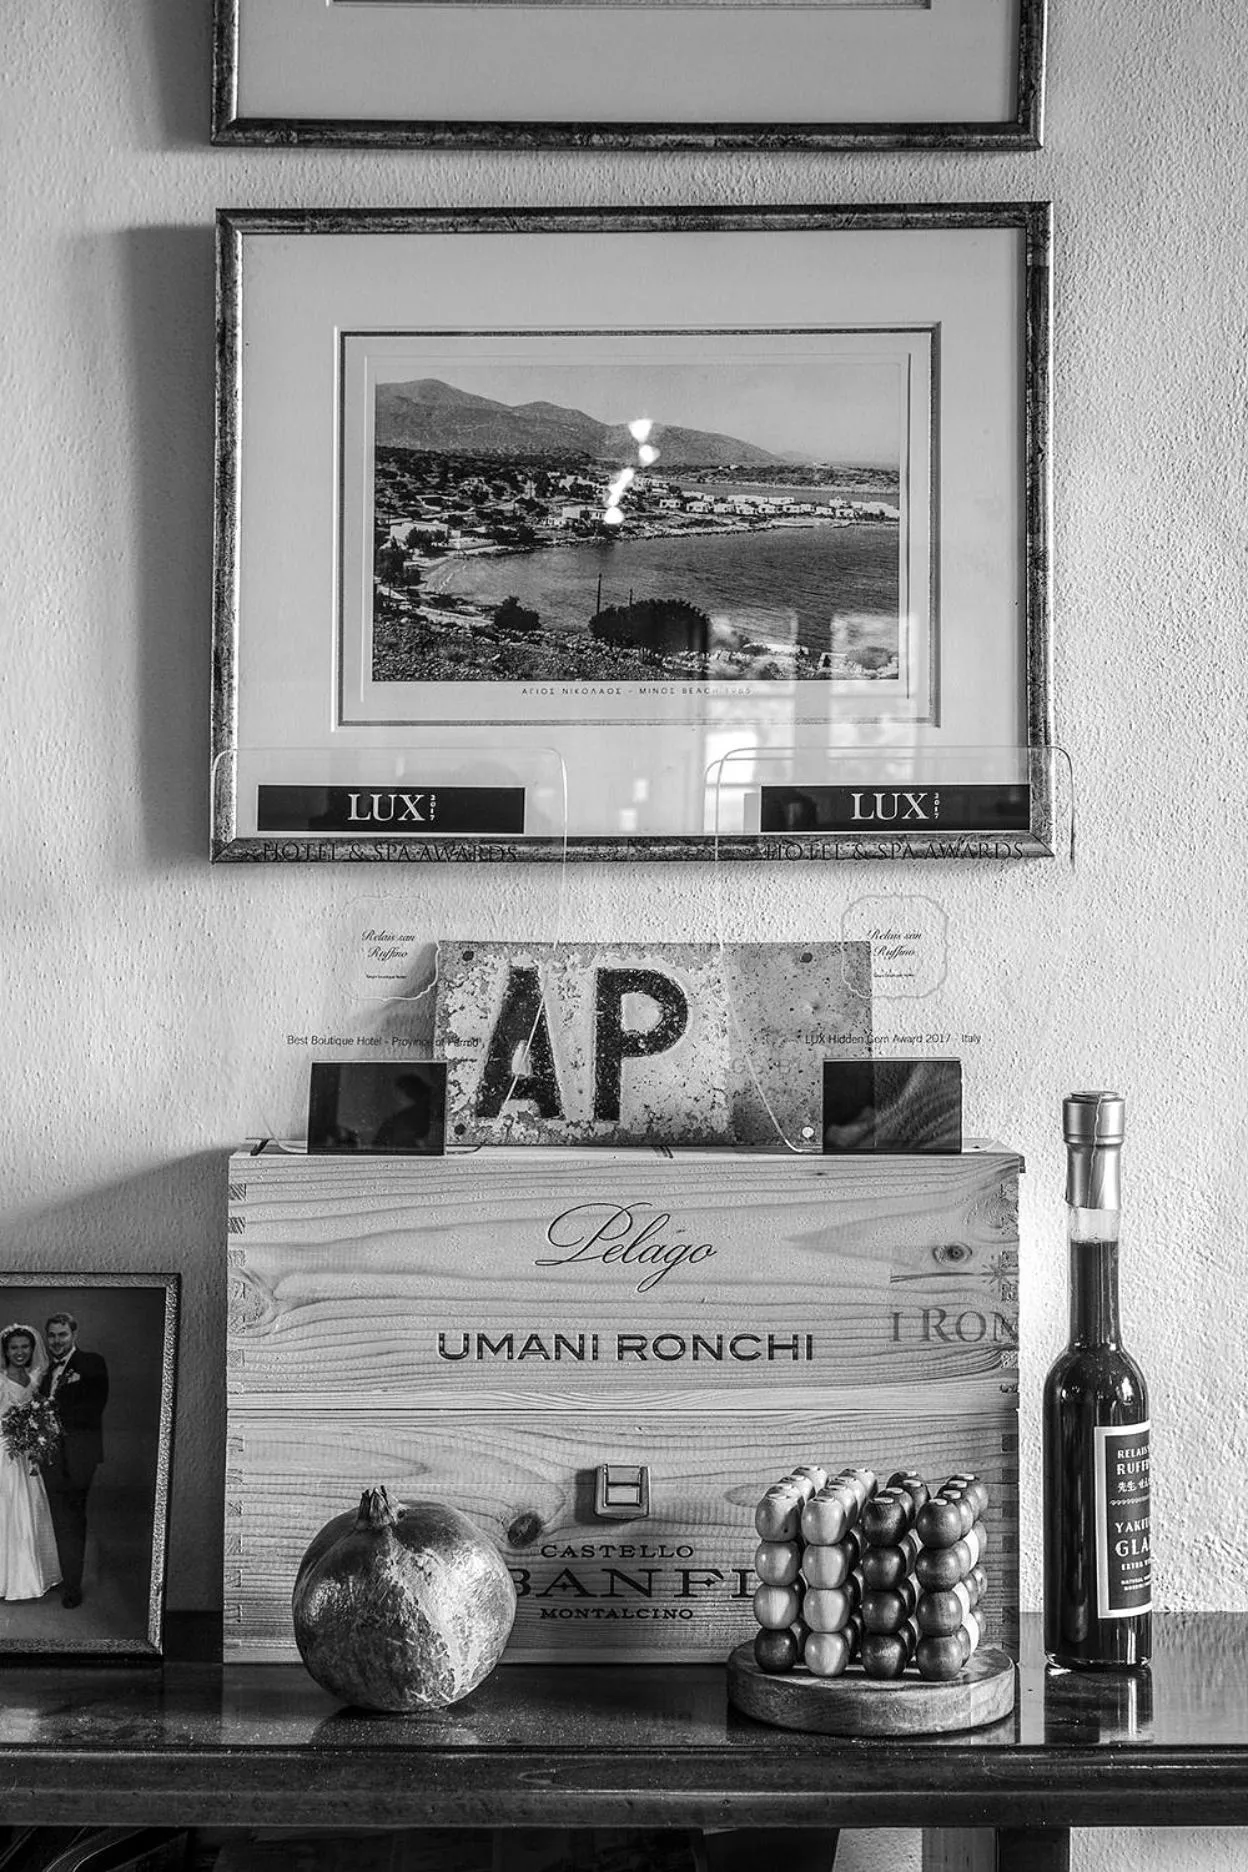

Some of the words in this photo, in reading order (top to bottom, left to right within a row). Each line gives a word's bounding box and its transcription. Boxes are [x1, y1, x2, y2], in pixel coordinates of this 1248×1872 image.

[347, 793, 426, 821] LUX
[850, 792, 930, 820] LUX
[264, 842, 339, 861] HOTEL
[350, 842, 364, 861] &
[375, 842, 414, 861] SPA
[419, 843, 518, 862] AWARDS
[767, 842, 844, 861] HOTEL
[854, 842, 869, 860] &
[878, 842, 917, 860] SPA
[925, 842, 1024, 860] AWARDS
[286, 1035, 308, 1046] Best
[311, 1035, 354, 1047] Boutique
[357, 1036, 383, 1046] Hotel
[474, 965, 688, 1121] AP
[805, 1034, 826, 1045] LUX
[828, 1034, 863, 1044] Hidden
[893, 1034, 923, 1044] Award
[925, 1034, 951, 1043] 2017
[961, 1034, 982, 1046] Italy
[534, 1201, 717, 1293] Pelago
[438, 1332, 599, 1361] UMANI
[616, 1332, 813, 1361] RONCHI
[541, 1545, 694, 1558] CASTELLO
[508, 1567, 756, 1598] BANFI
[540, 1607, 694, 1620] MONTALCINO
